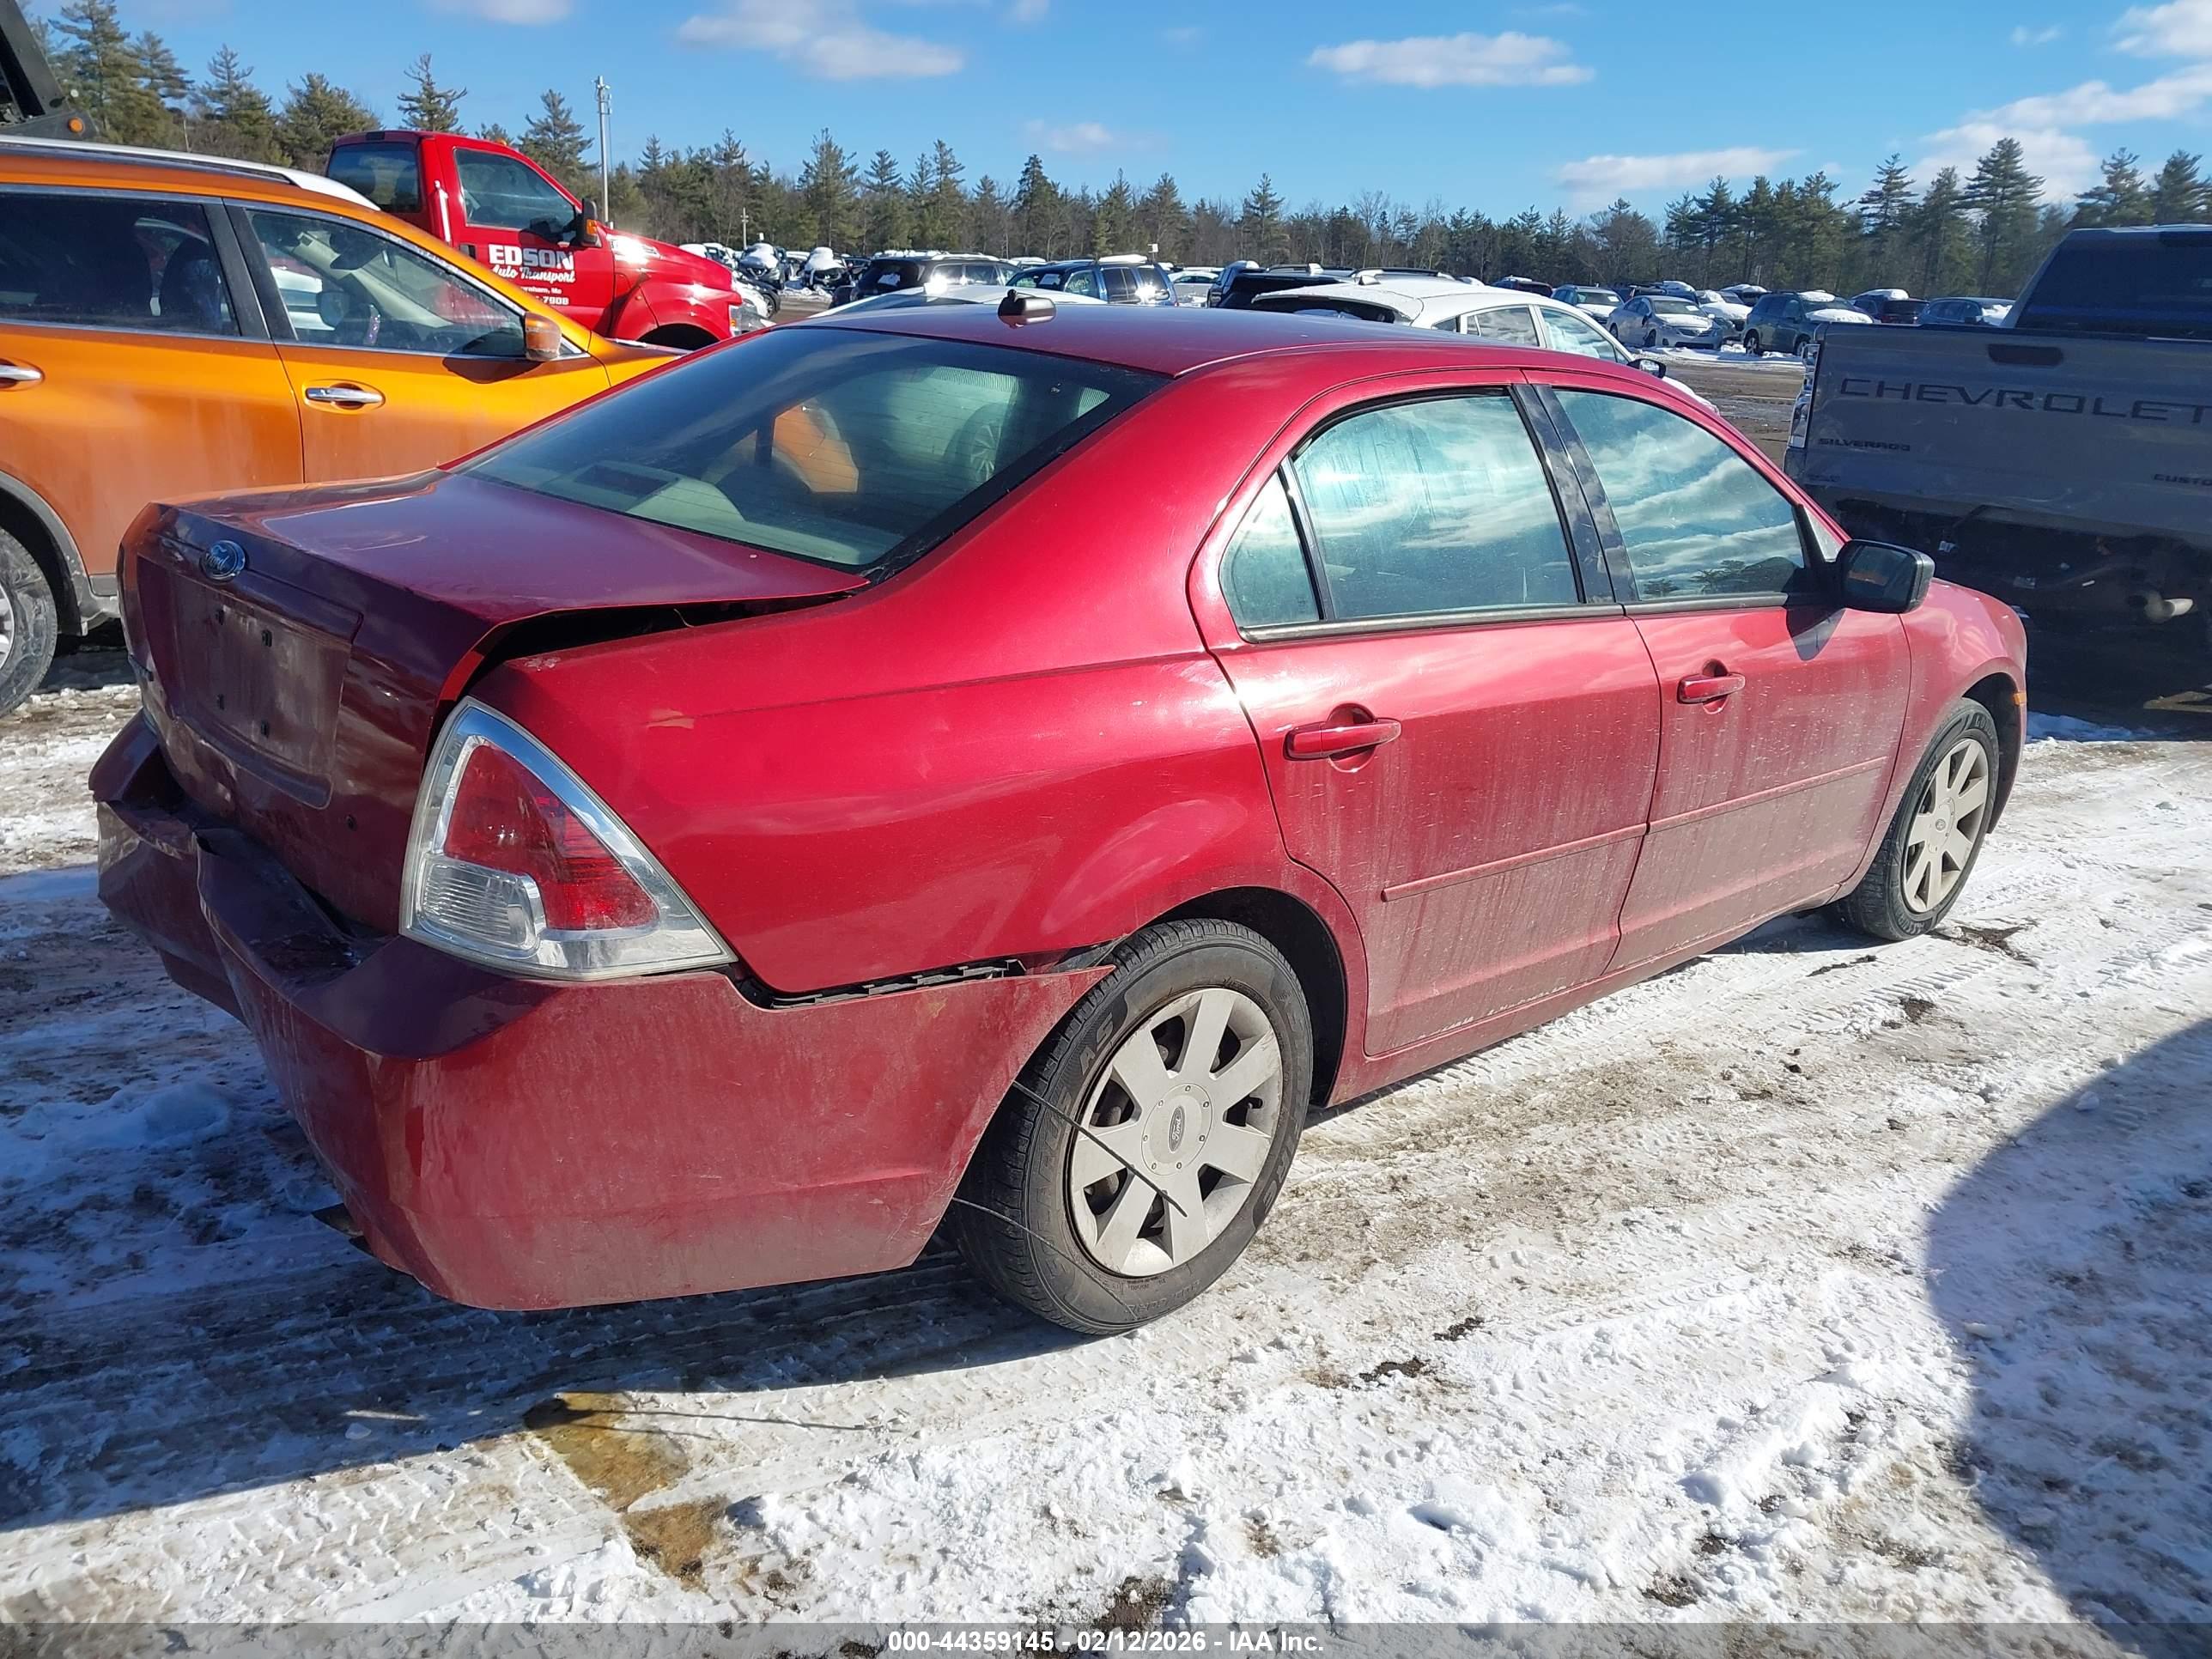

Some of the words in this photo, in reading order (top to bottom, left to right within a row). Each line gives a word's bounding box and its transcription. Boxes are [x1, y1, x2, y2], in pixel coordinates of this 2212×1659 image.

[488, 244, 574, 270] EDSON
[491, 264, 519, 279] Auto
[520, 267, 576, 284] Transport
[1839, 378, 2212, 424] CHEVROLET
[1818, 438, 1911, 453] SILVERADO
